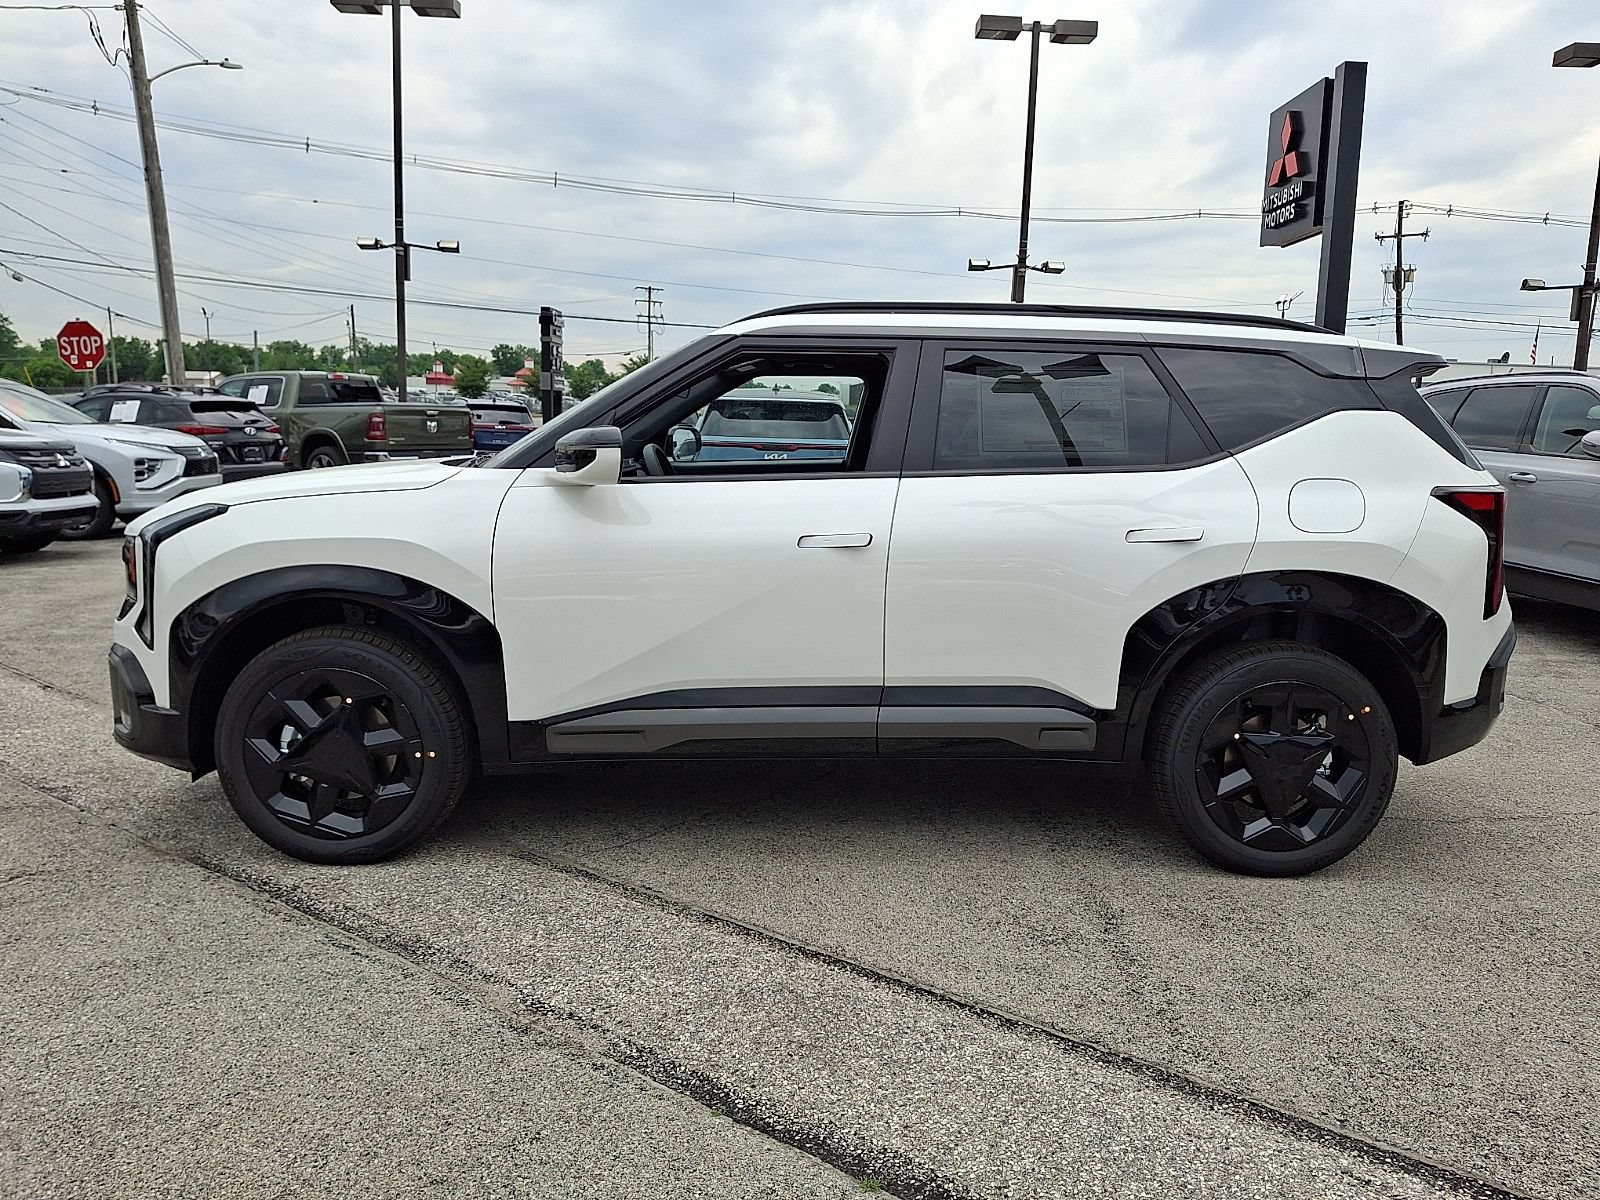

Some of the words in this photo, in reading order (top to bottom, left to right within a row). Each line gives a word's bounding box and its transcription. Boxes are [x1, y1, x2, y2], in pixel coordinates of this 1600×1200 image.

[1262, 180, 1303, 212] MITSUBISHI
[1264, 202, 1295, 230] MOTORS
[60, 336, 101, 356] STOP
[1179, 698, 1212, 753] KUMHO
